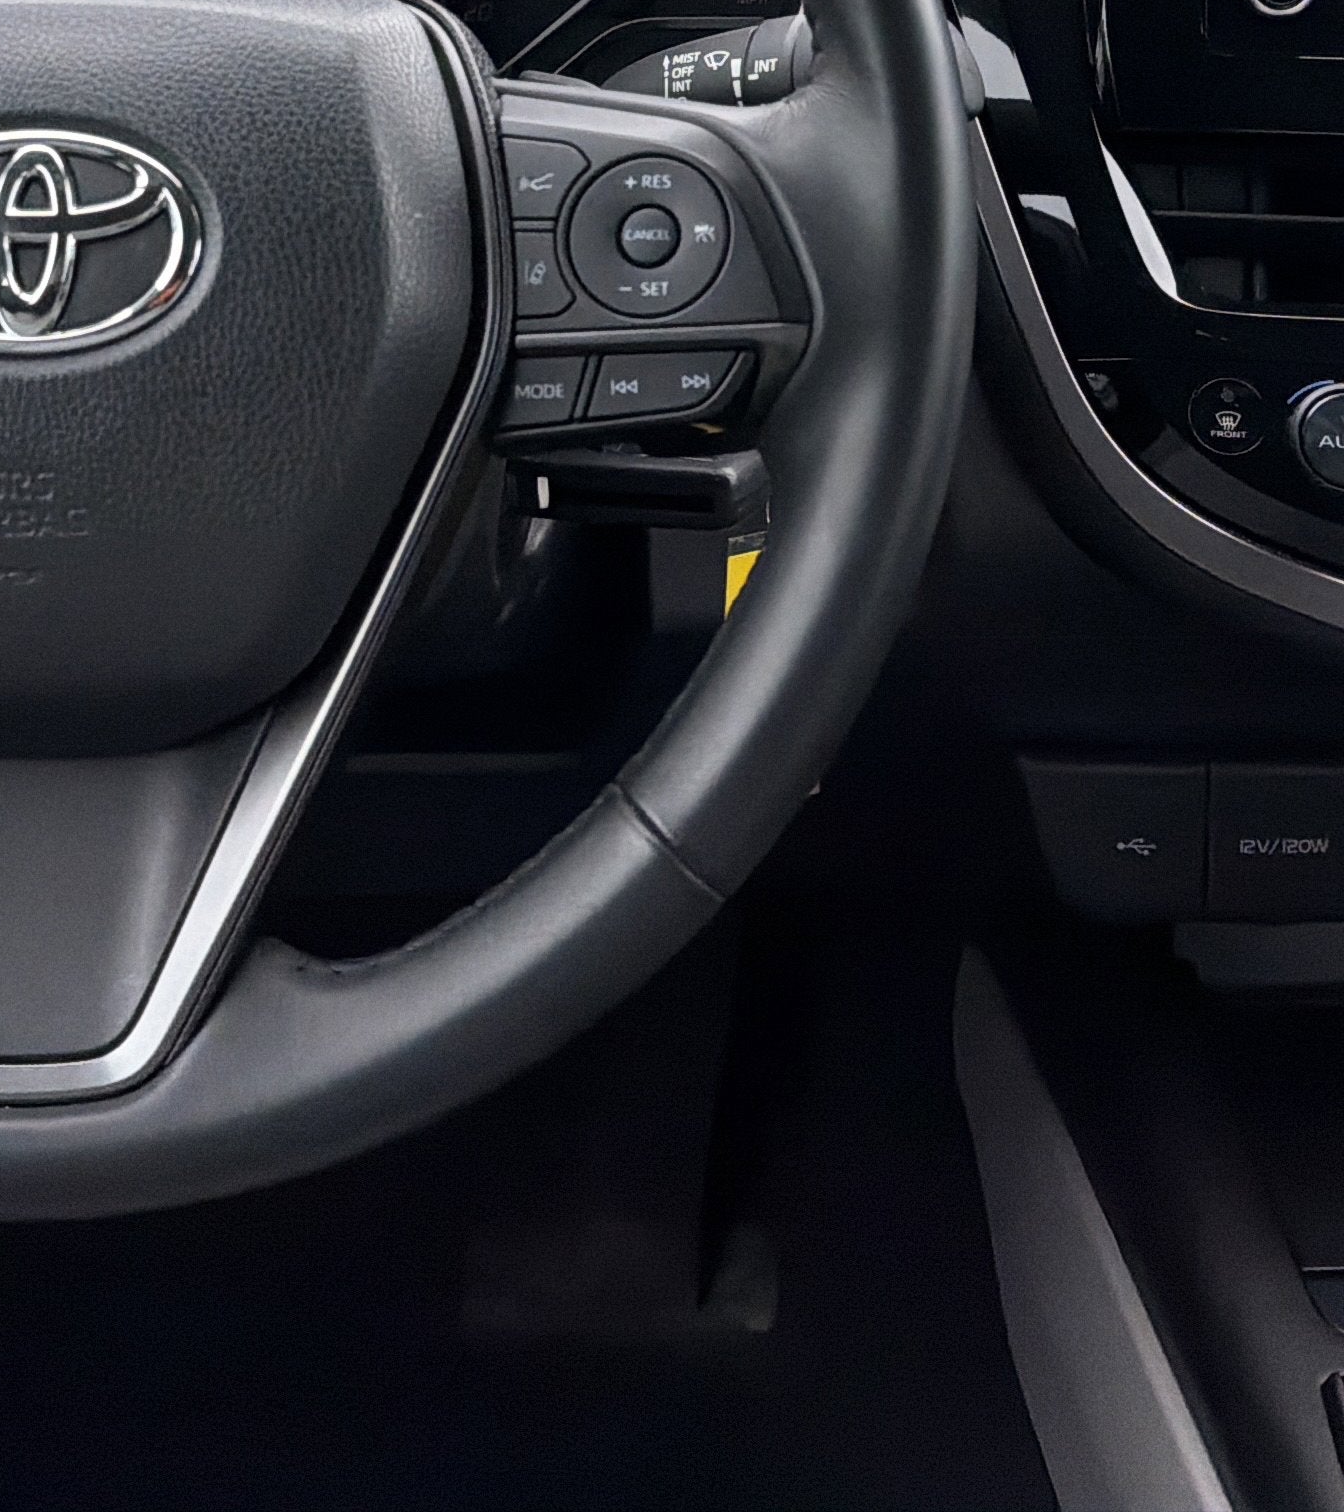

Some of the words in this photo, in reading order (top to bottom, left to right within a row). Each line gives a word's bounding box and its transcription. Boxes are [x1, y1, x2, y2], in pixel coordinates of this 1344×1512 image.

[672, 51, 701, 65] MIST
[754, 57, 778, 74] INT
[671, 65, 695, 79] OFF
[672, 79, 693, 93] INT
[641, 174, 672, 189] RES
[640, 281, 669, 297] SET
[514, 383, 565, 400] MODE
[1210, 430, 1248, 440] FRONT
[1239, 838, 1329, 856] 12V/120W
